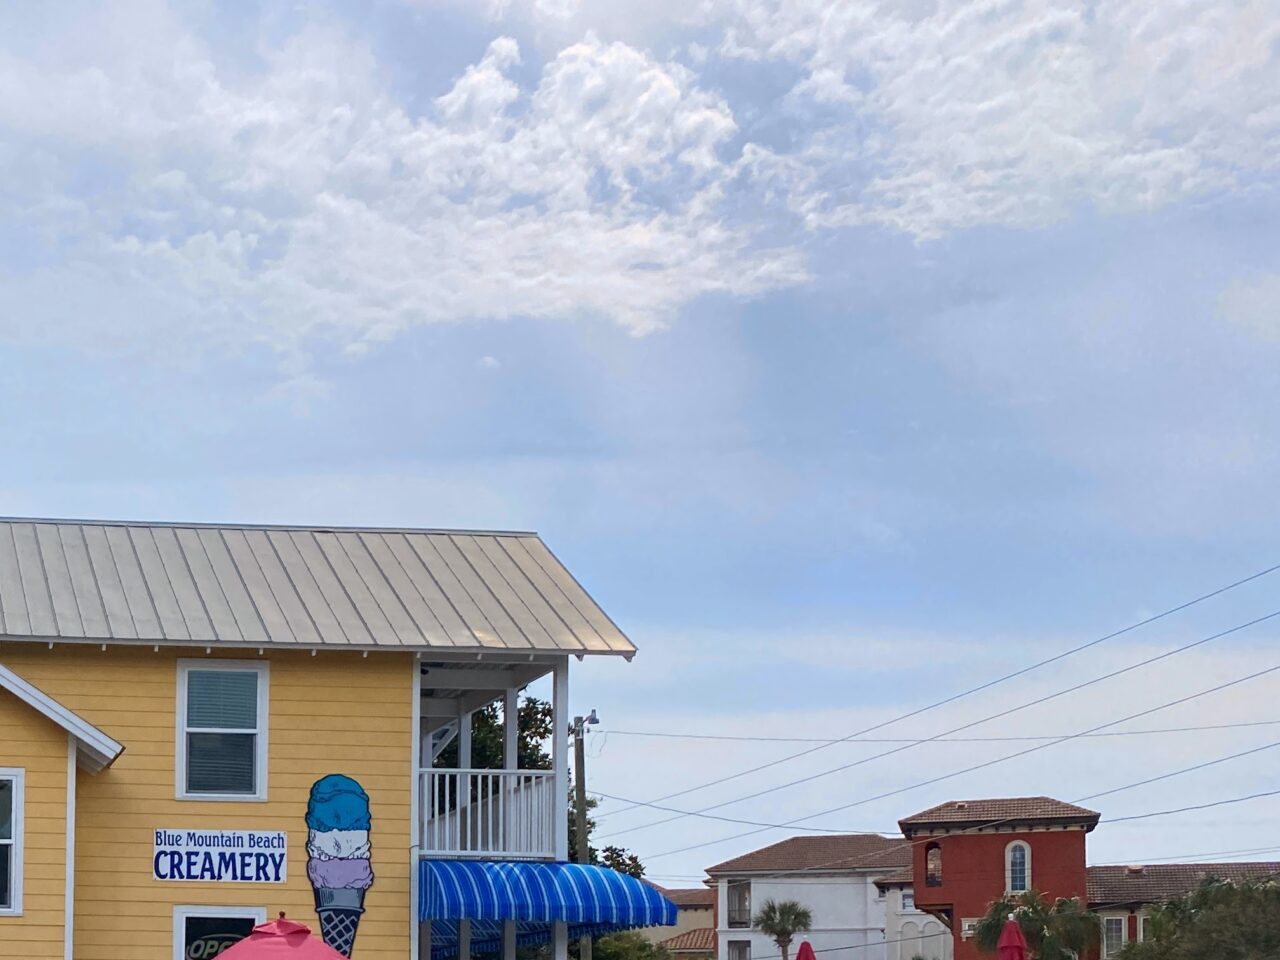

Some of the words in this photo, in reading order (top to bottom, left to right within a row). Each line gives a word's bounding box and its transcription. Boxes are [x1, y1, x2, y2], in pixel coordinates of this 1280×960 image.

[155, 831, 182, 846] Blue
[186, 832, 244, 848] Mountain
[248, 833, 285, 848] Beach
[154, 850, 285, 881] CREAMERY
